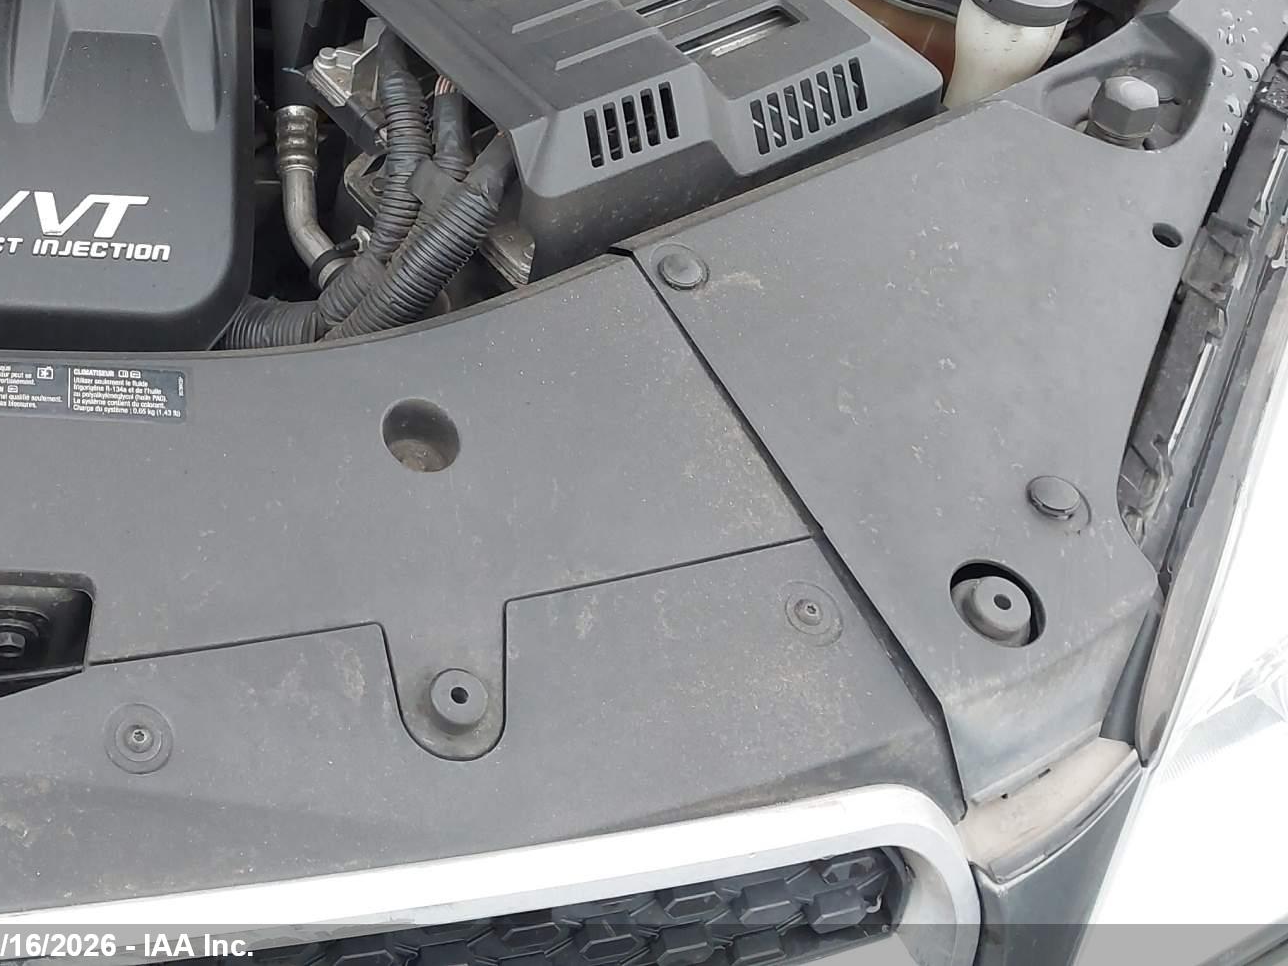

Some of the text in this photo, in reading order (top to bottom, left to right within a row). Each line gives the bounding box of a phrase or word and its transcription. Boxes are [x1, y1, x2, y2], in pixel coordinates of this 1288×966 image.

[32, 239, 172, 262] INJECTION
[74, 369, 114, 377] CLIMATISEUR
[94, 378, 124, 386] seulement
[107, 399, 131, 407] contient
[73, 404, 94, 413] Charge
